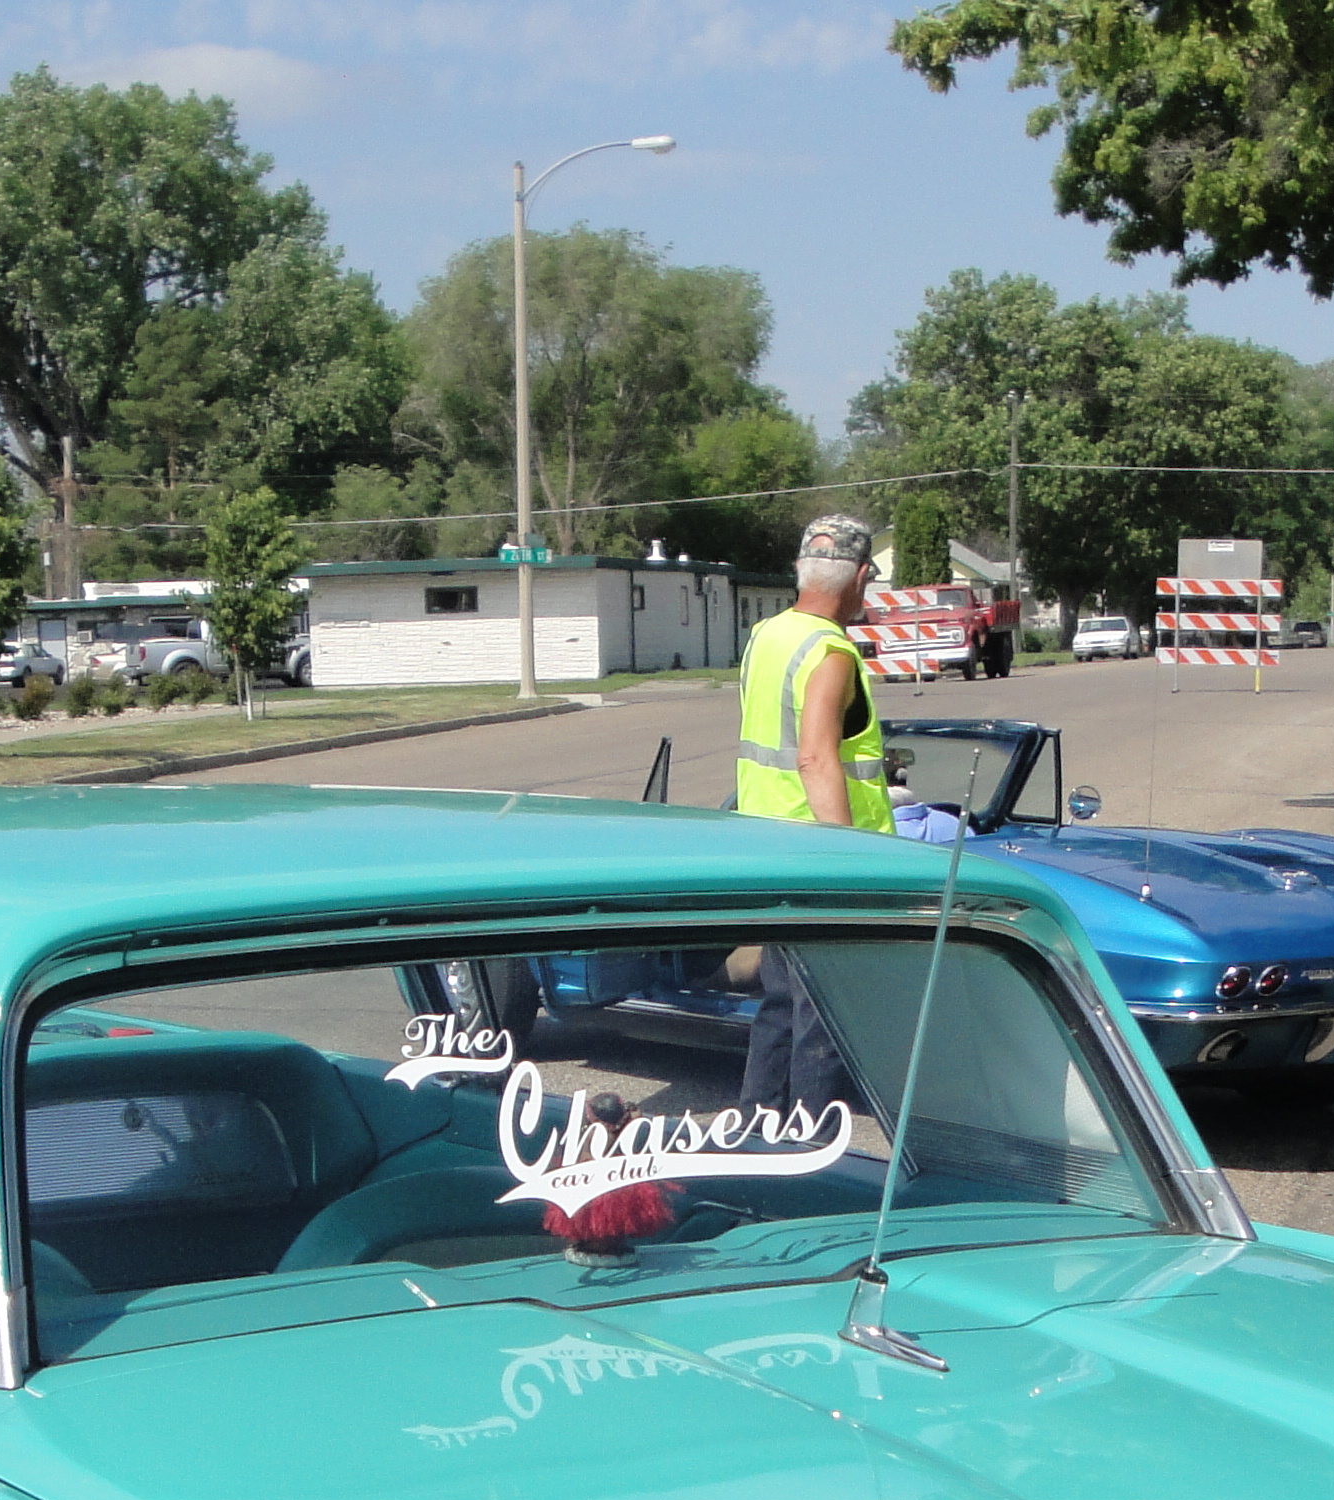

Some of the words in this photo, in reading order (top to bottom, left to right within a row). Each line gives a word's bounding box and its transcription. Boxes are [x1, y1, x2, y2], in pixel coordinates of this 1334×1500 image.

[389, 1013, 513, 1076] The
[496, 1060, 853, 1195] Chasers
[551, 1172, 595, 1189] car
[607, 1156, 662, 1182] club
